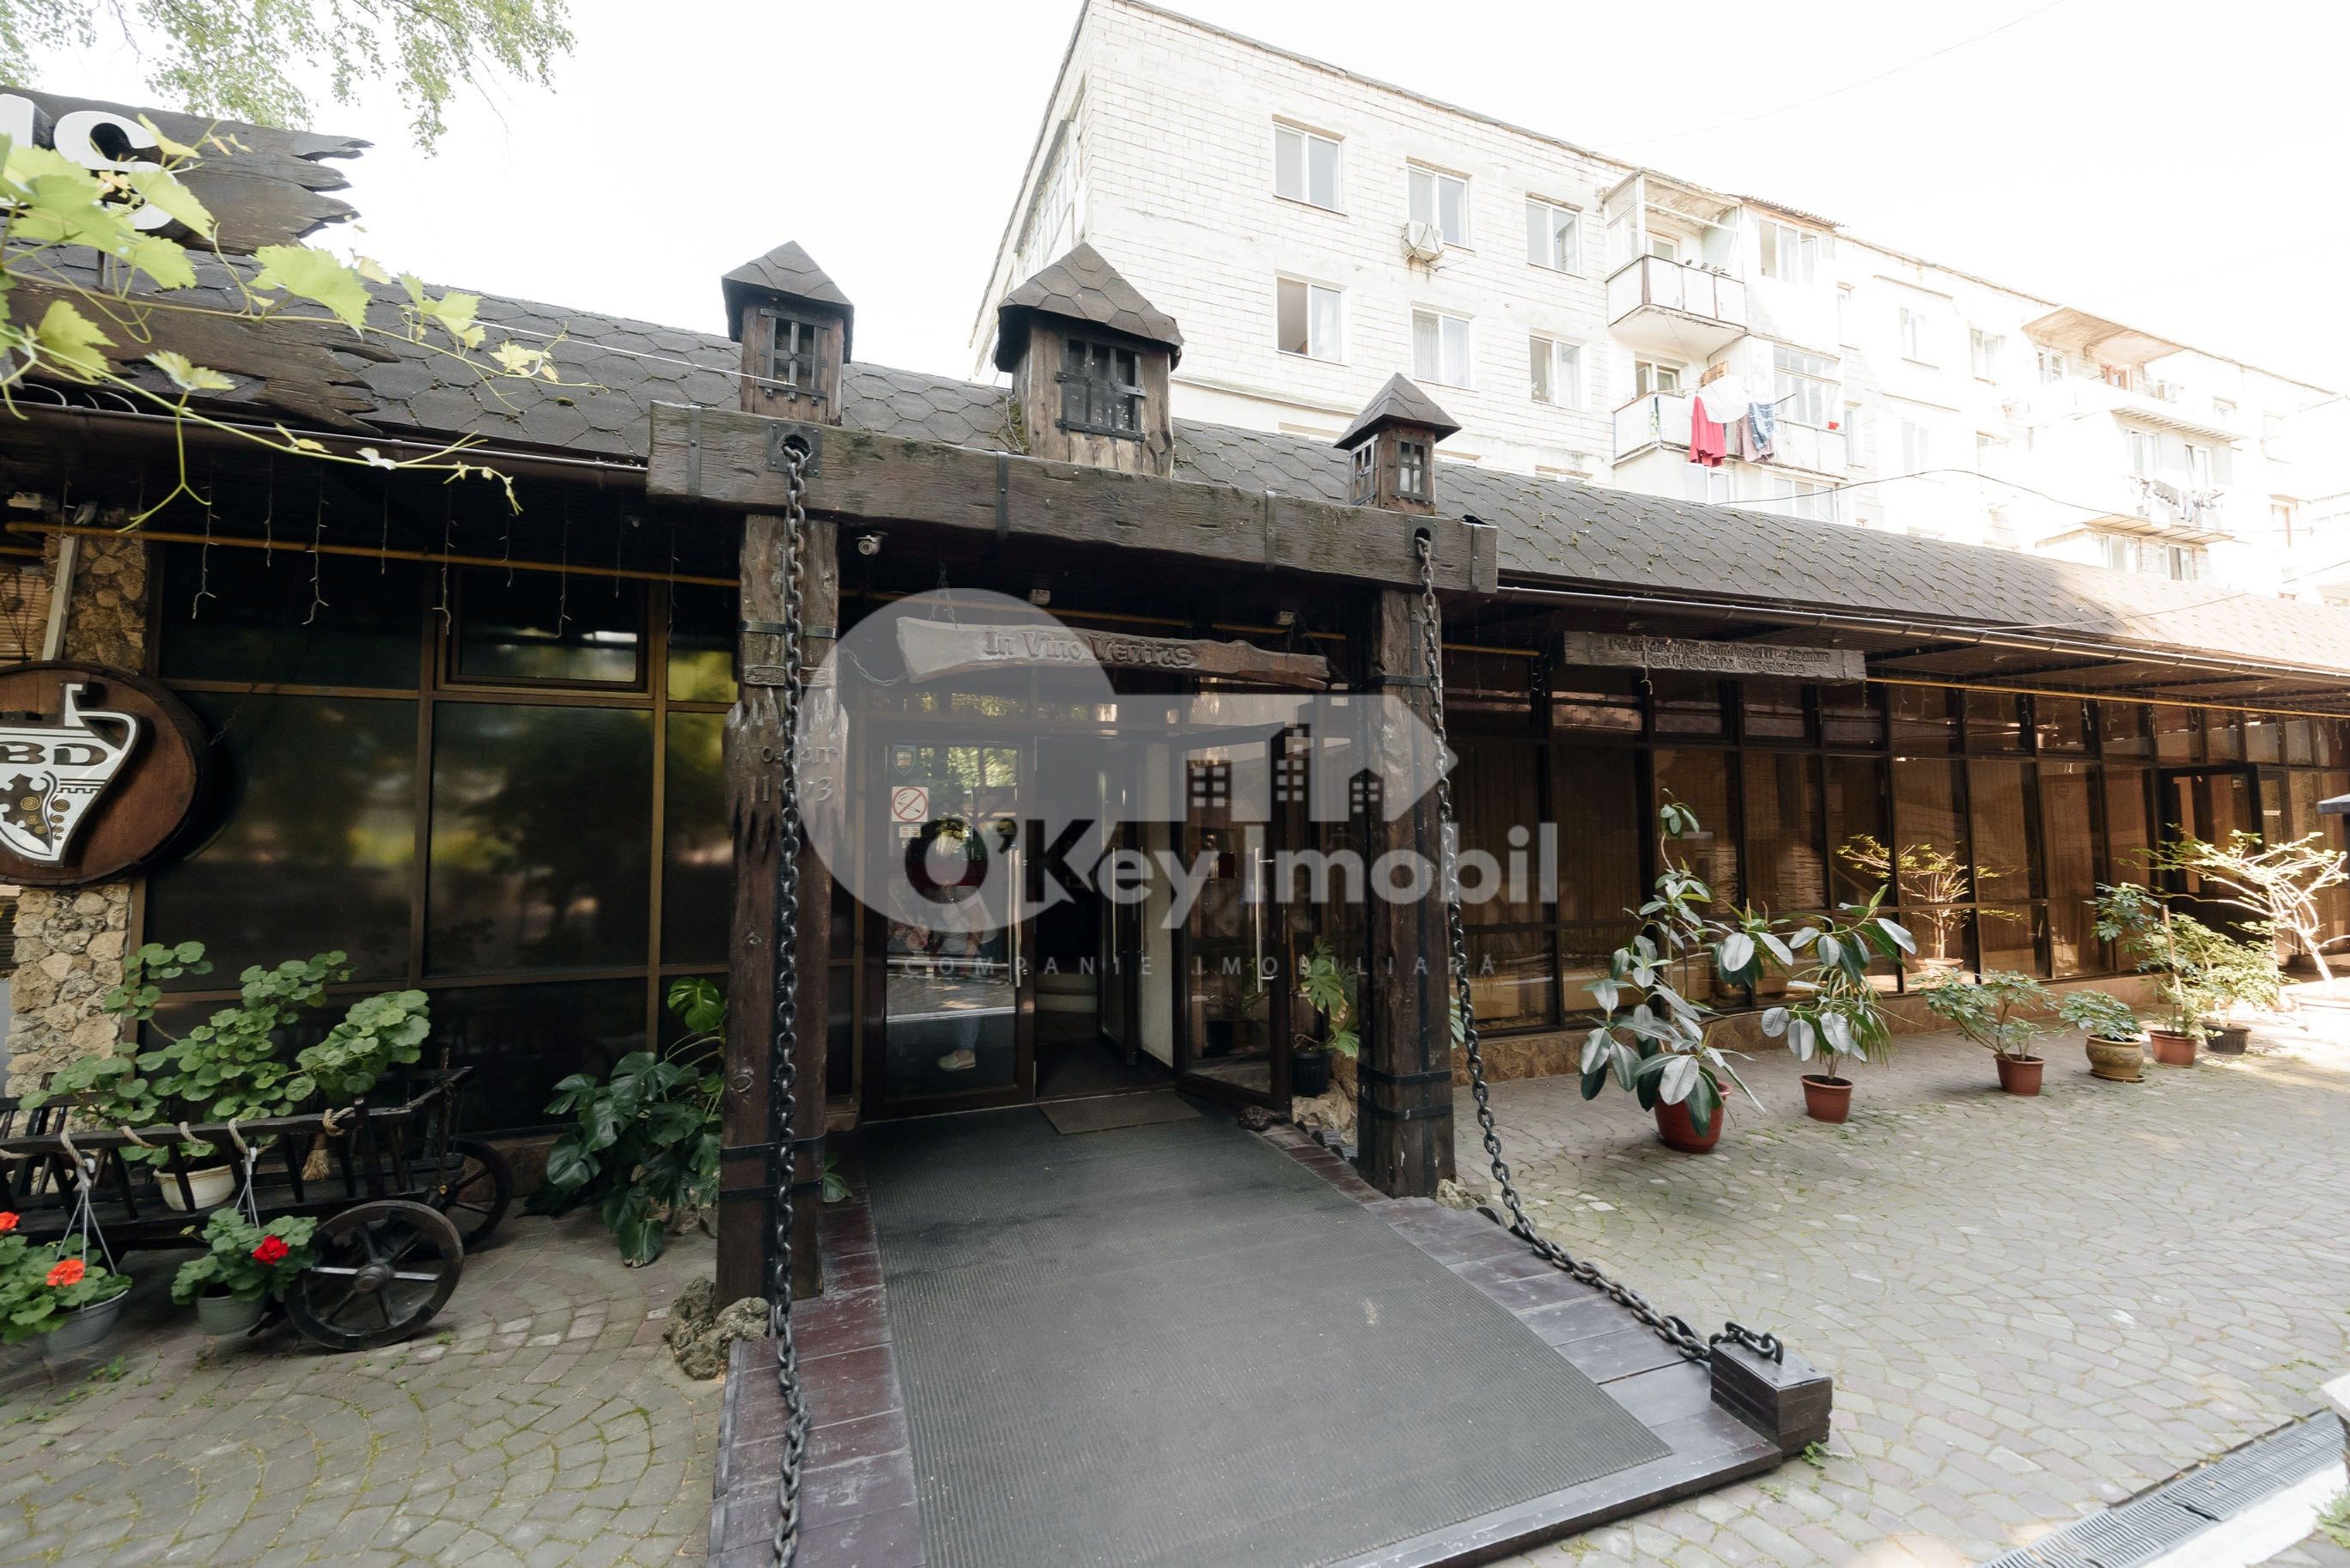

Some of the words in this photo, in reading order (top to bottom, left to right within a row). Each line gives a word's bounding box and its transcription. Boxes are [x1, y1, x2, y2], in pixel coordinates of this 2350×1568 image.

[983, 629, 1016, 656] In
[1022, 631, 1081, 659] Vino
[1089, 634, 1196, 666] Veritas
